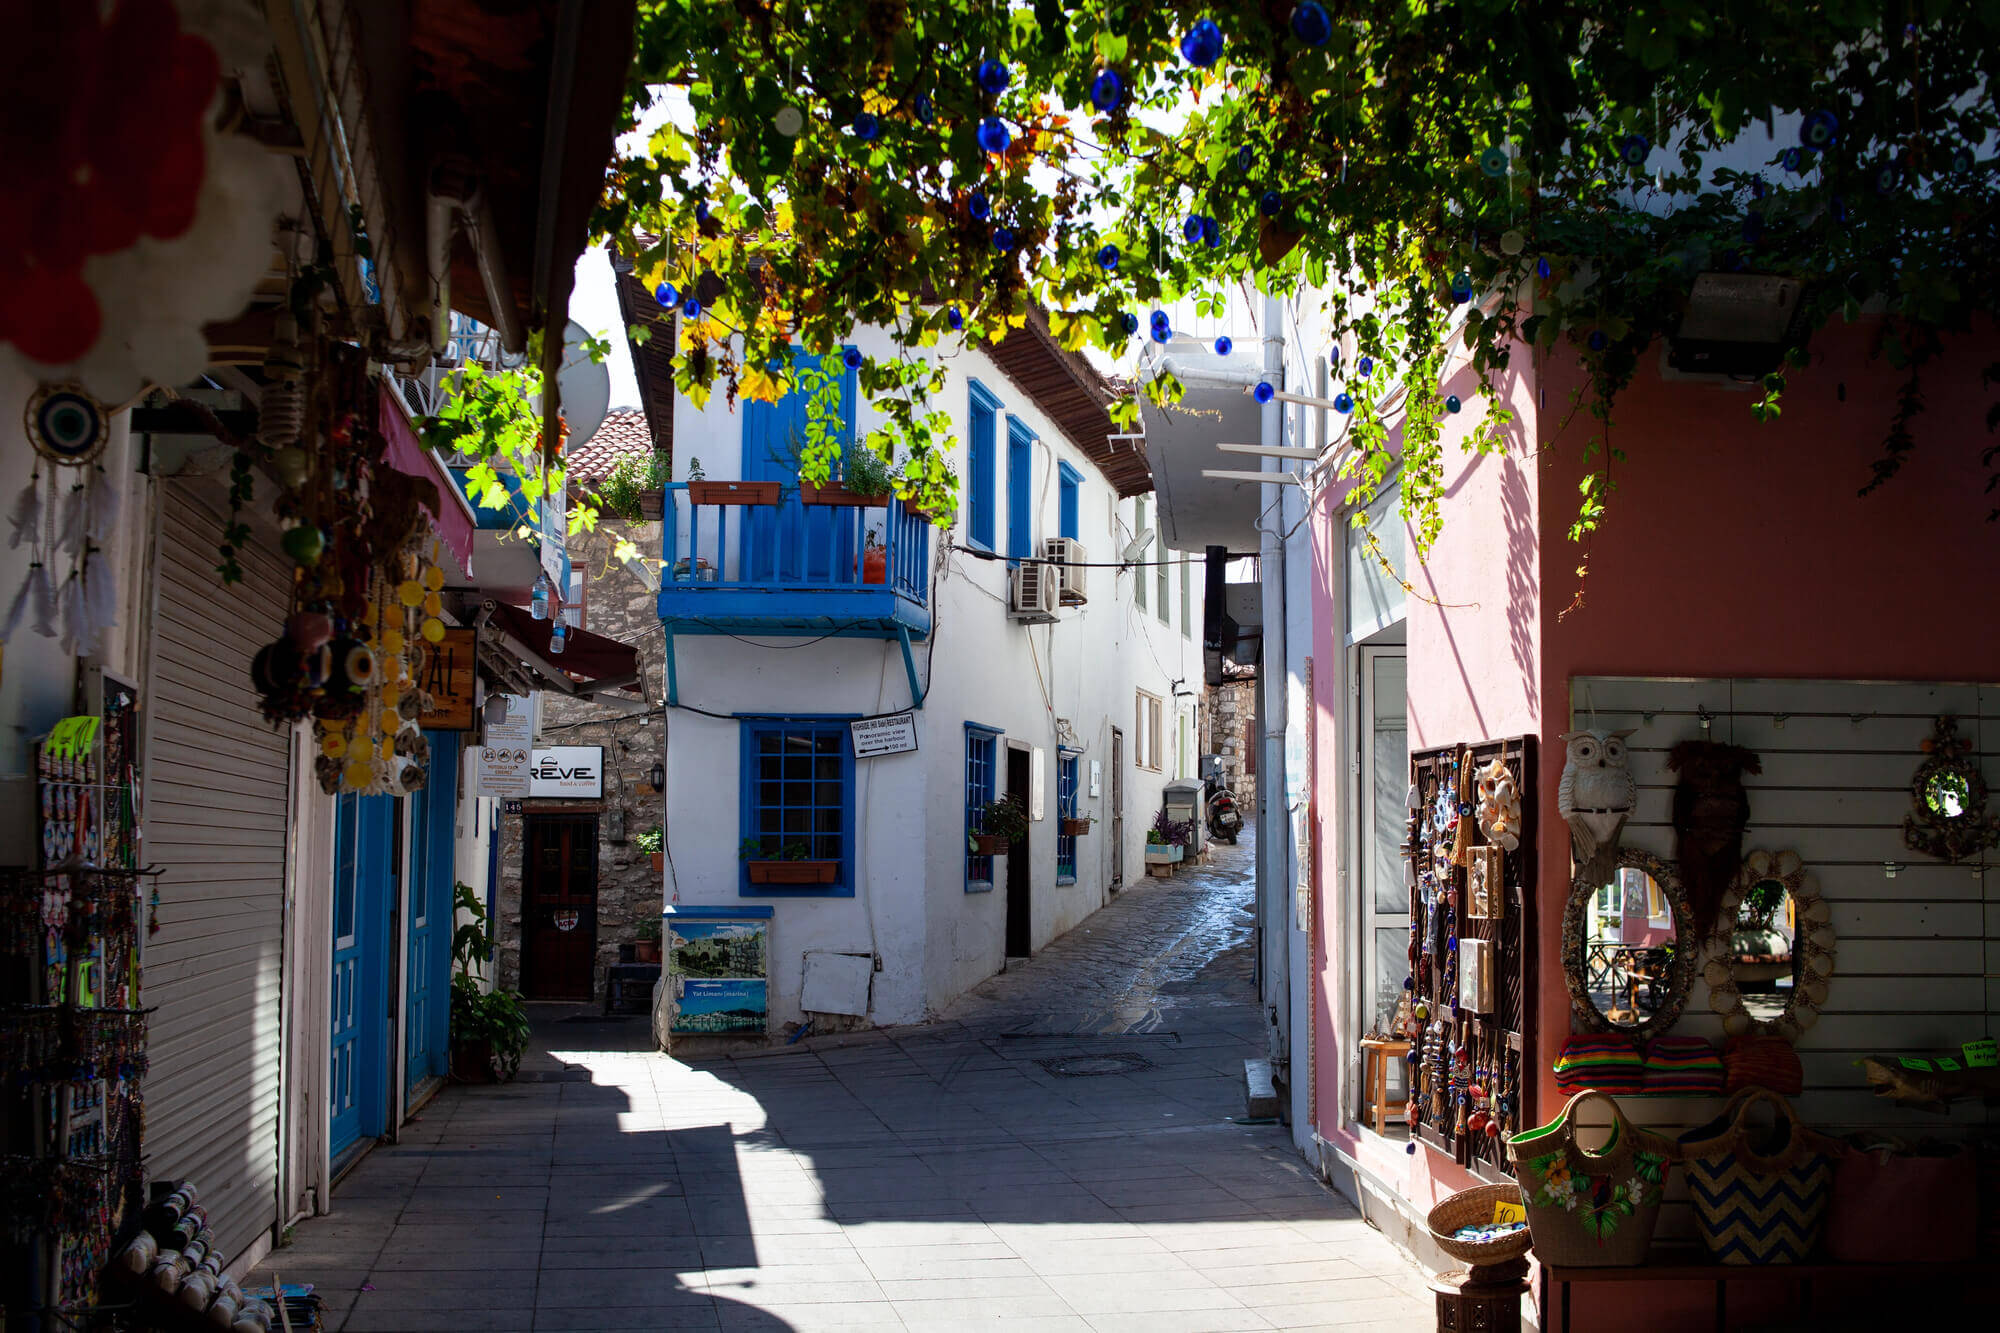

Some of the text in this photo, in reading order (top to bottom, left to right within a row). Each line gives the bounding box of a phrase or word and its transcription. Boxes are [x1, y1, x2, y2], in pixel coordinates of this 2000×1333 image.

[859, 731, 891, 739] Panoramic
[884, 735, 906, 743] harbour
[1499, 1207, 1515, 1223] 10
